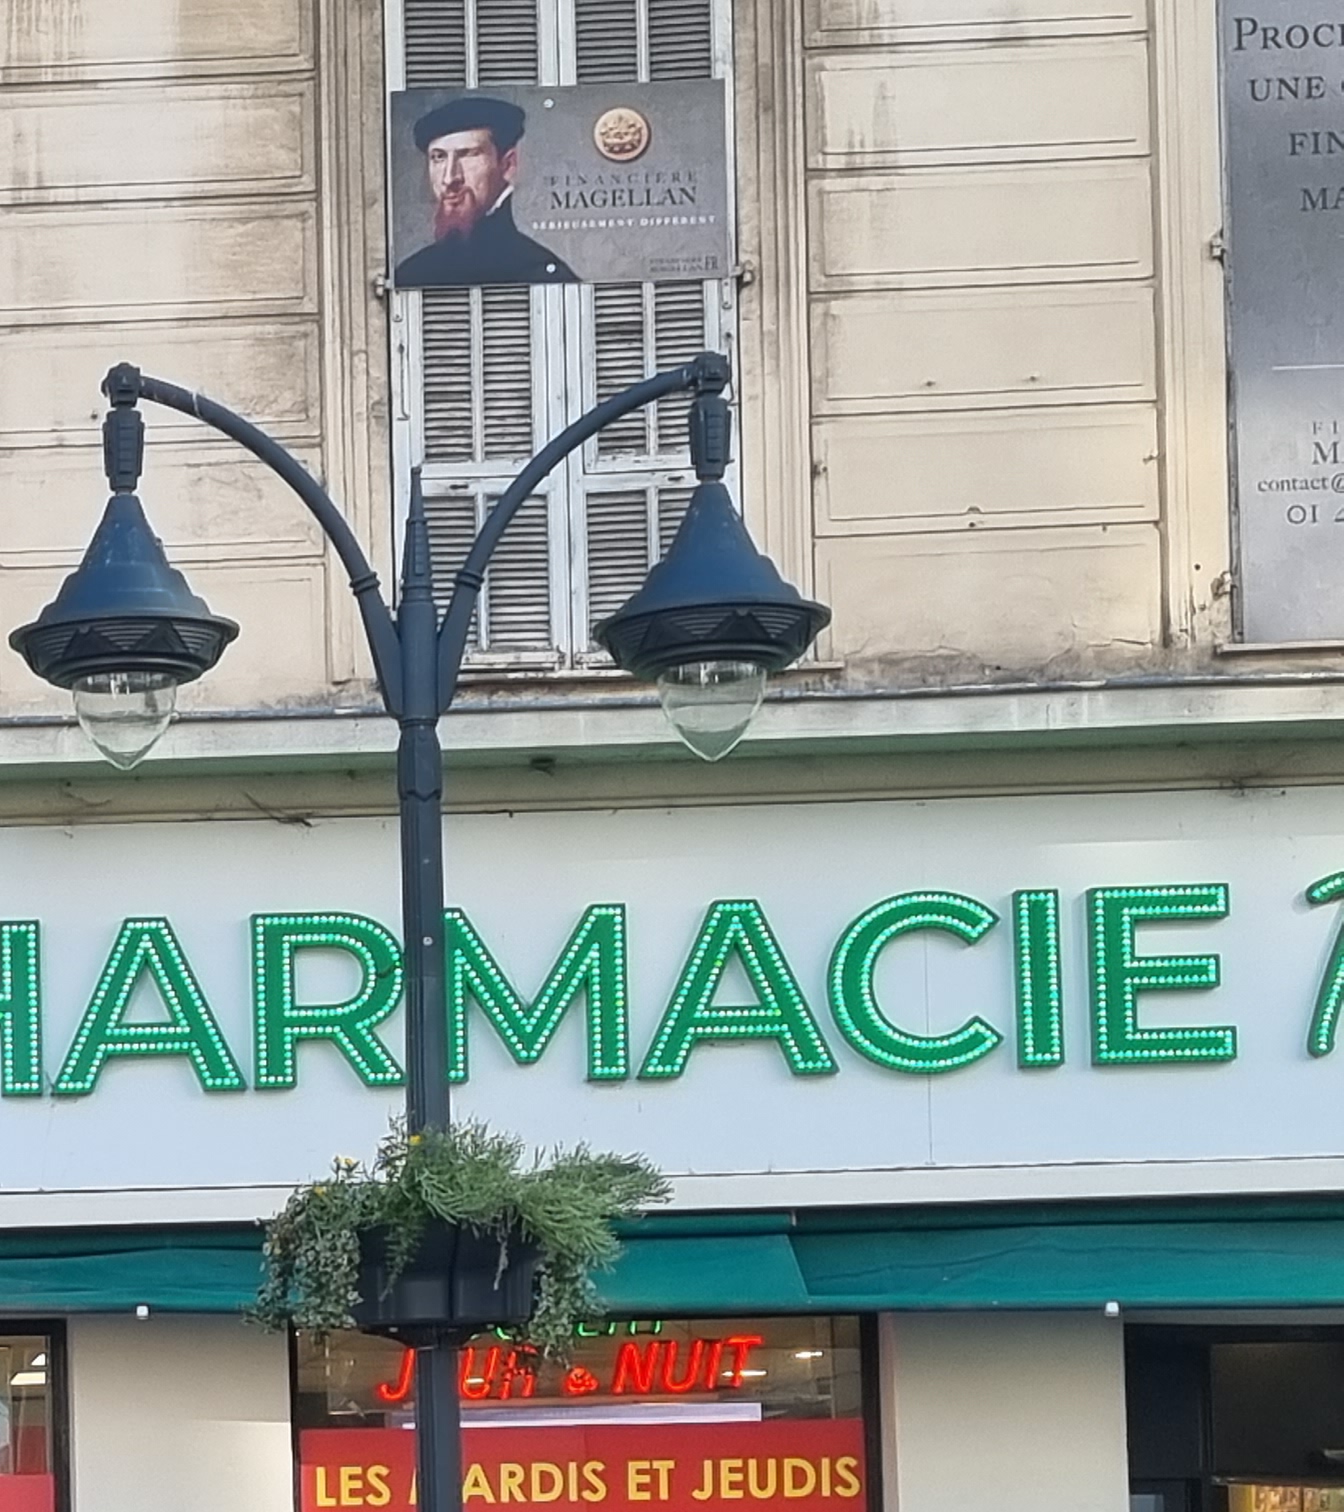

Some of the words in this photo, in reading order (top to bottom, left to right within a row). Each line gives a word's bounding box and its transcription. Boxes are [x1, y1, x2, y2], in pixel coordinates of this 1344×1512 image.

[1233, 17, 1344, 51] PROC
[1248, 76, 1326, 102] UNE
[550, 186, 697, 210] MAGELLAN
[1313, 442, 1344, 464] M
[380, 1345, 540, 1401] JUR
[612, 1333, 764, 1394] NUIT
[316, 1466, 390, 1506] LES
[408, 1460, 608, 1503] ARDIS
[627, 1460, 676, 1501] ET
[692, 1456, 861, 1500] JEUDIS
